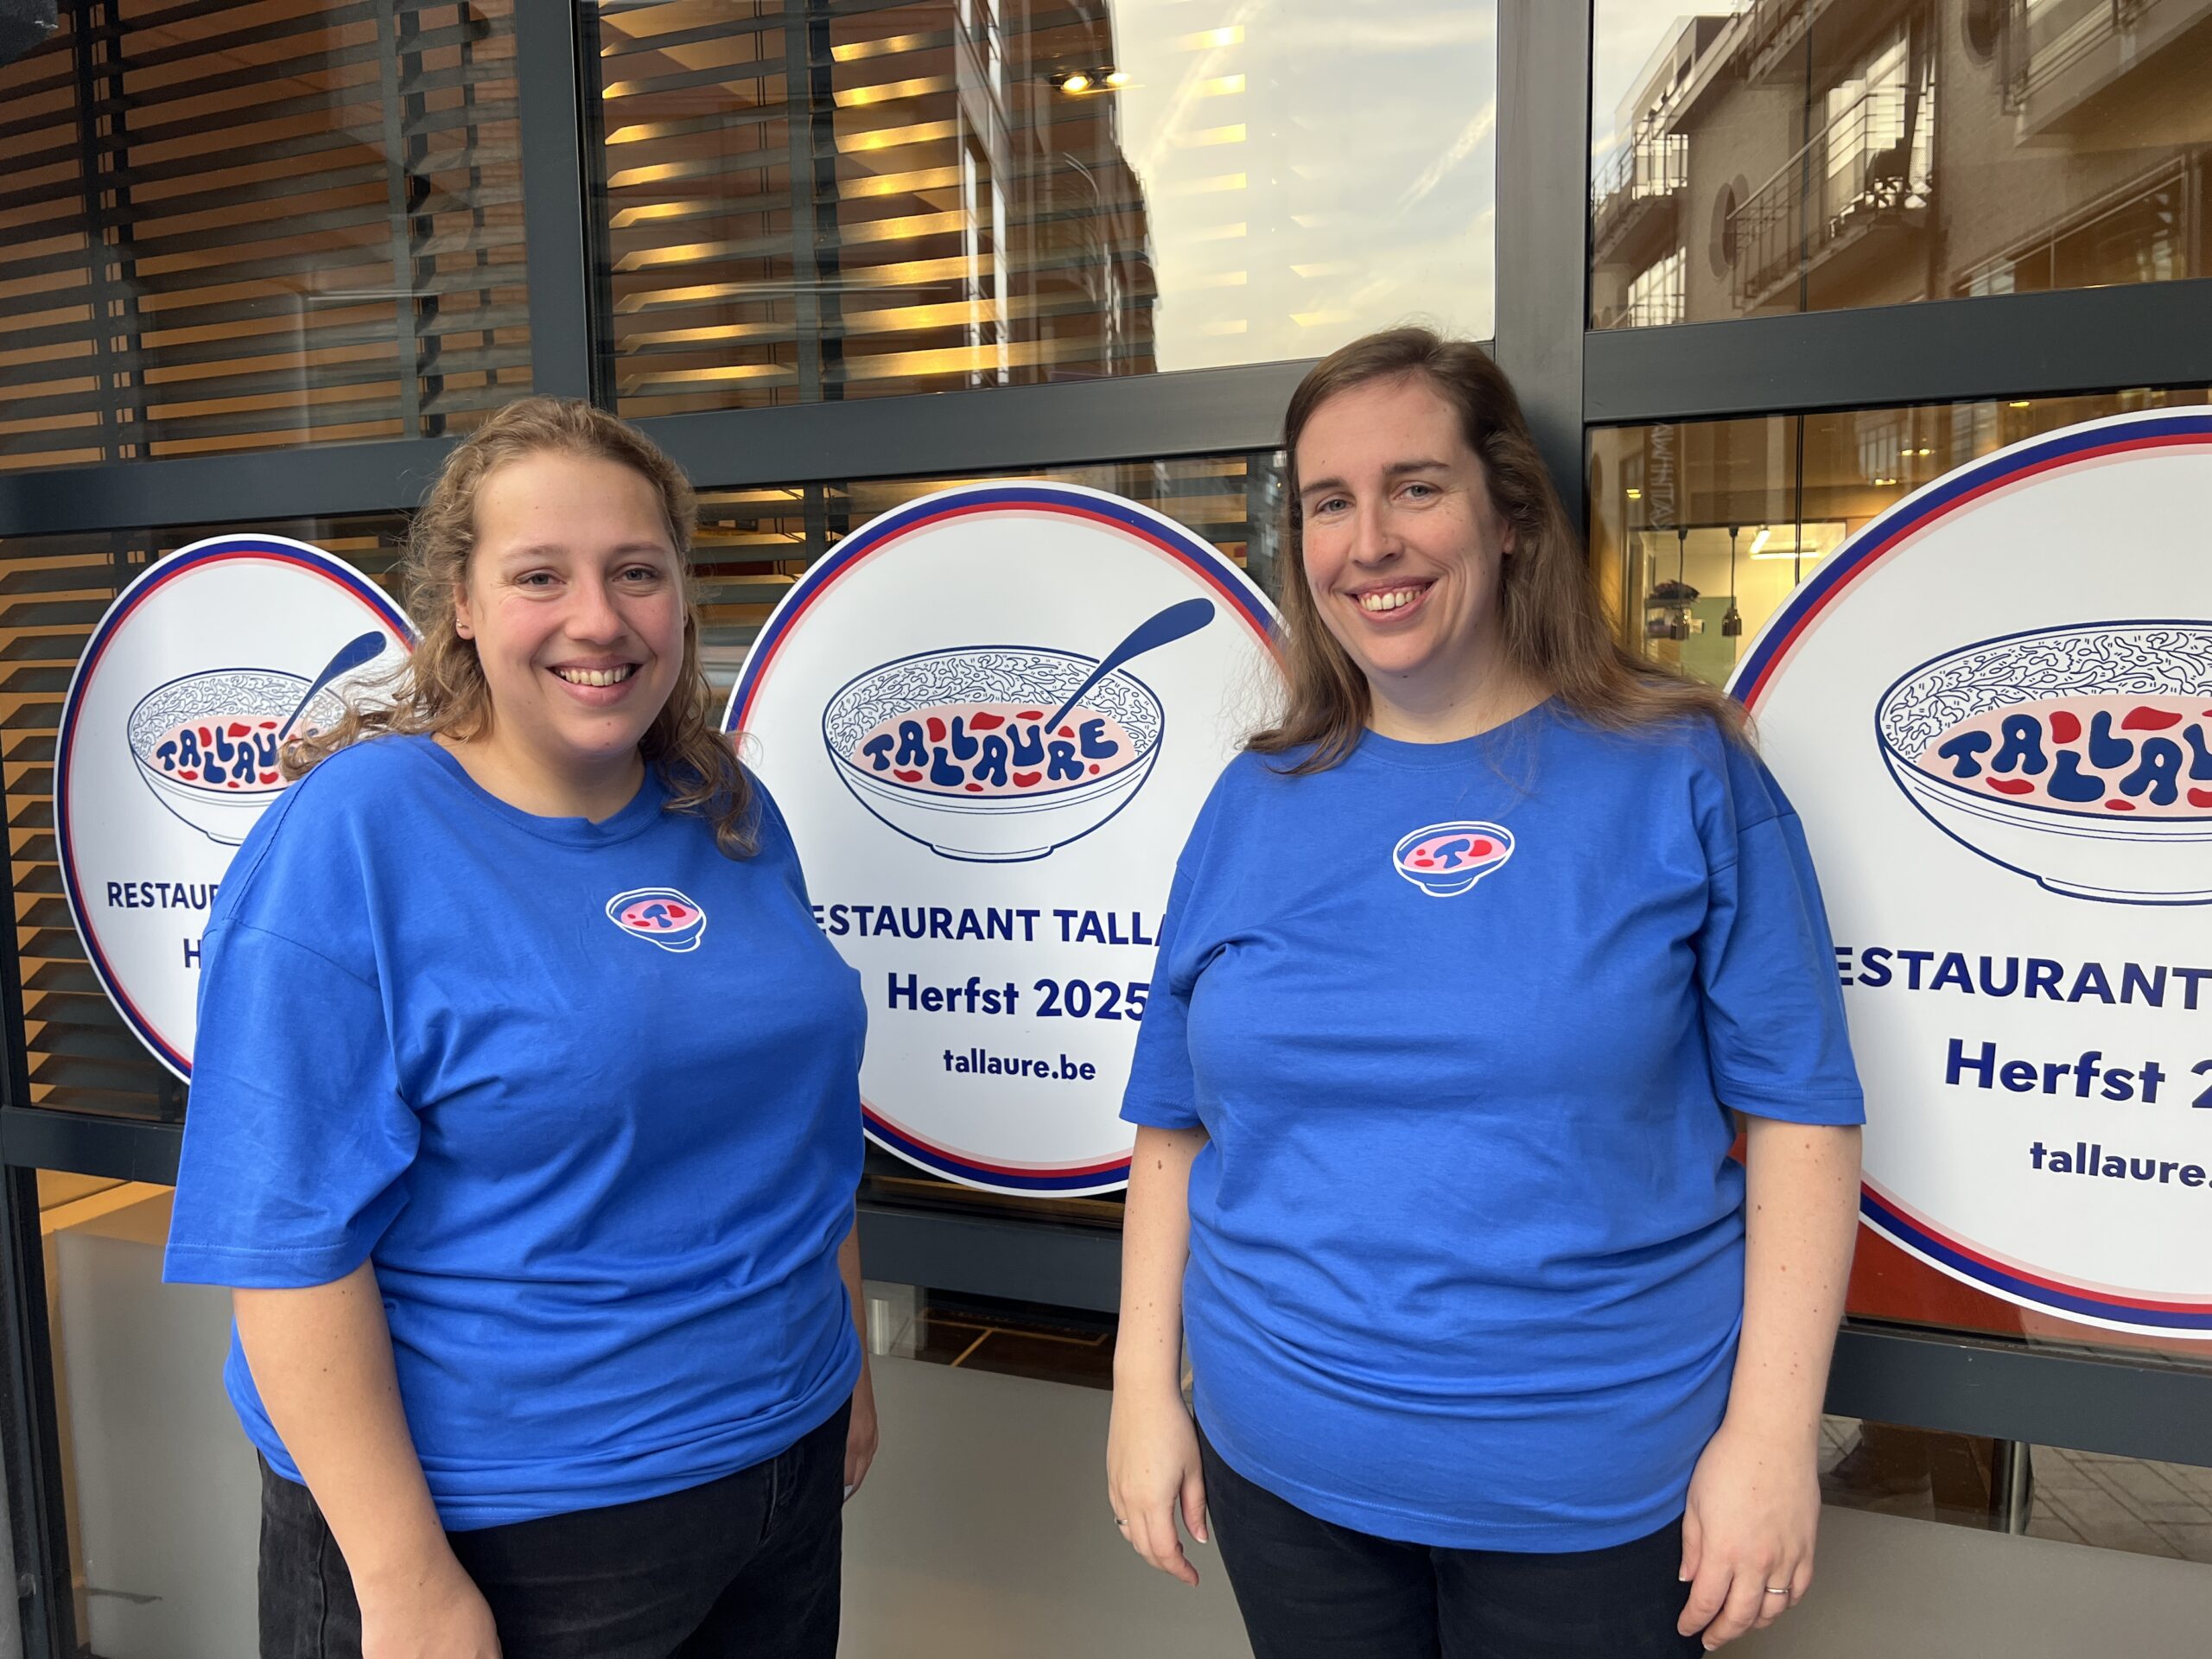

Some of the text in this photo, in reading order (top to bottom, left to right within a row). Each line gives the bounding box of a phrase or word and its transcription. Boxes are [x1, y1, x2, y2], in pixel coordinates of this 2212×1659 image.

[156, 726, 318, 784] TALLAU
[862, 715, 1119, 787] TALLAURE
[1433, 838, 1471, 869] T
[642, 904, 673, 928] T
[888, 972, 1150, 1022] Herfst 2025
[943, 1047, 1096, 1081] tallaure.be
[1946, 1038, 2165, 1103] Herfst
